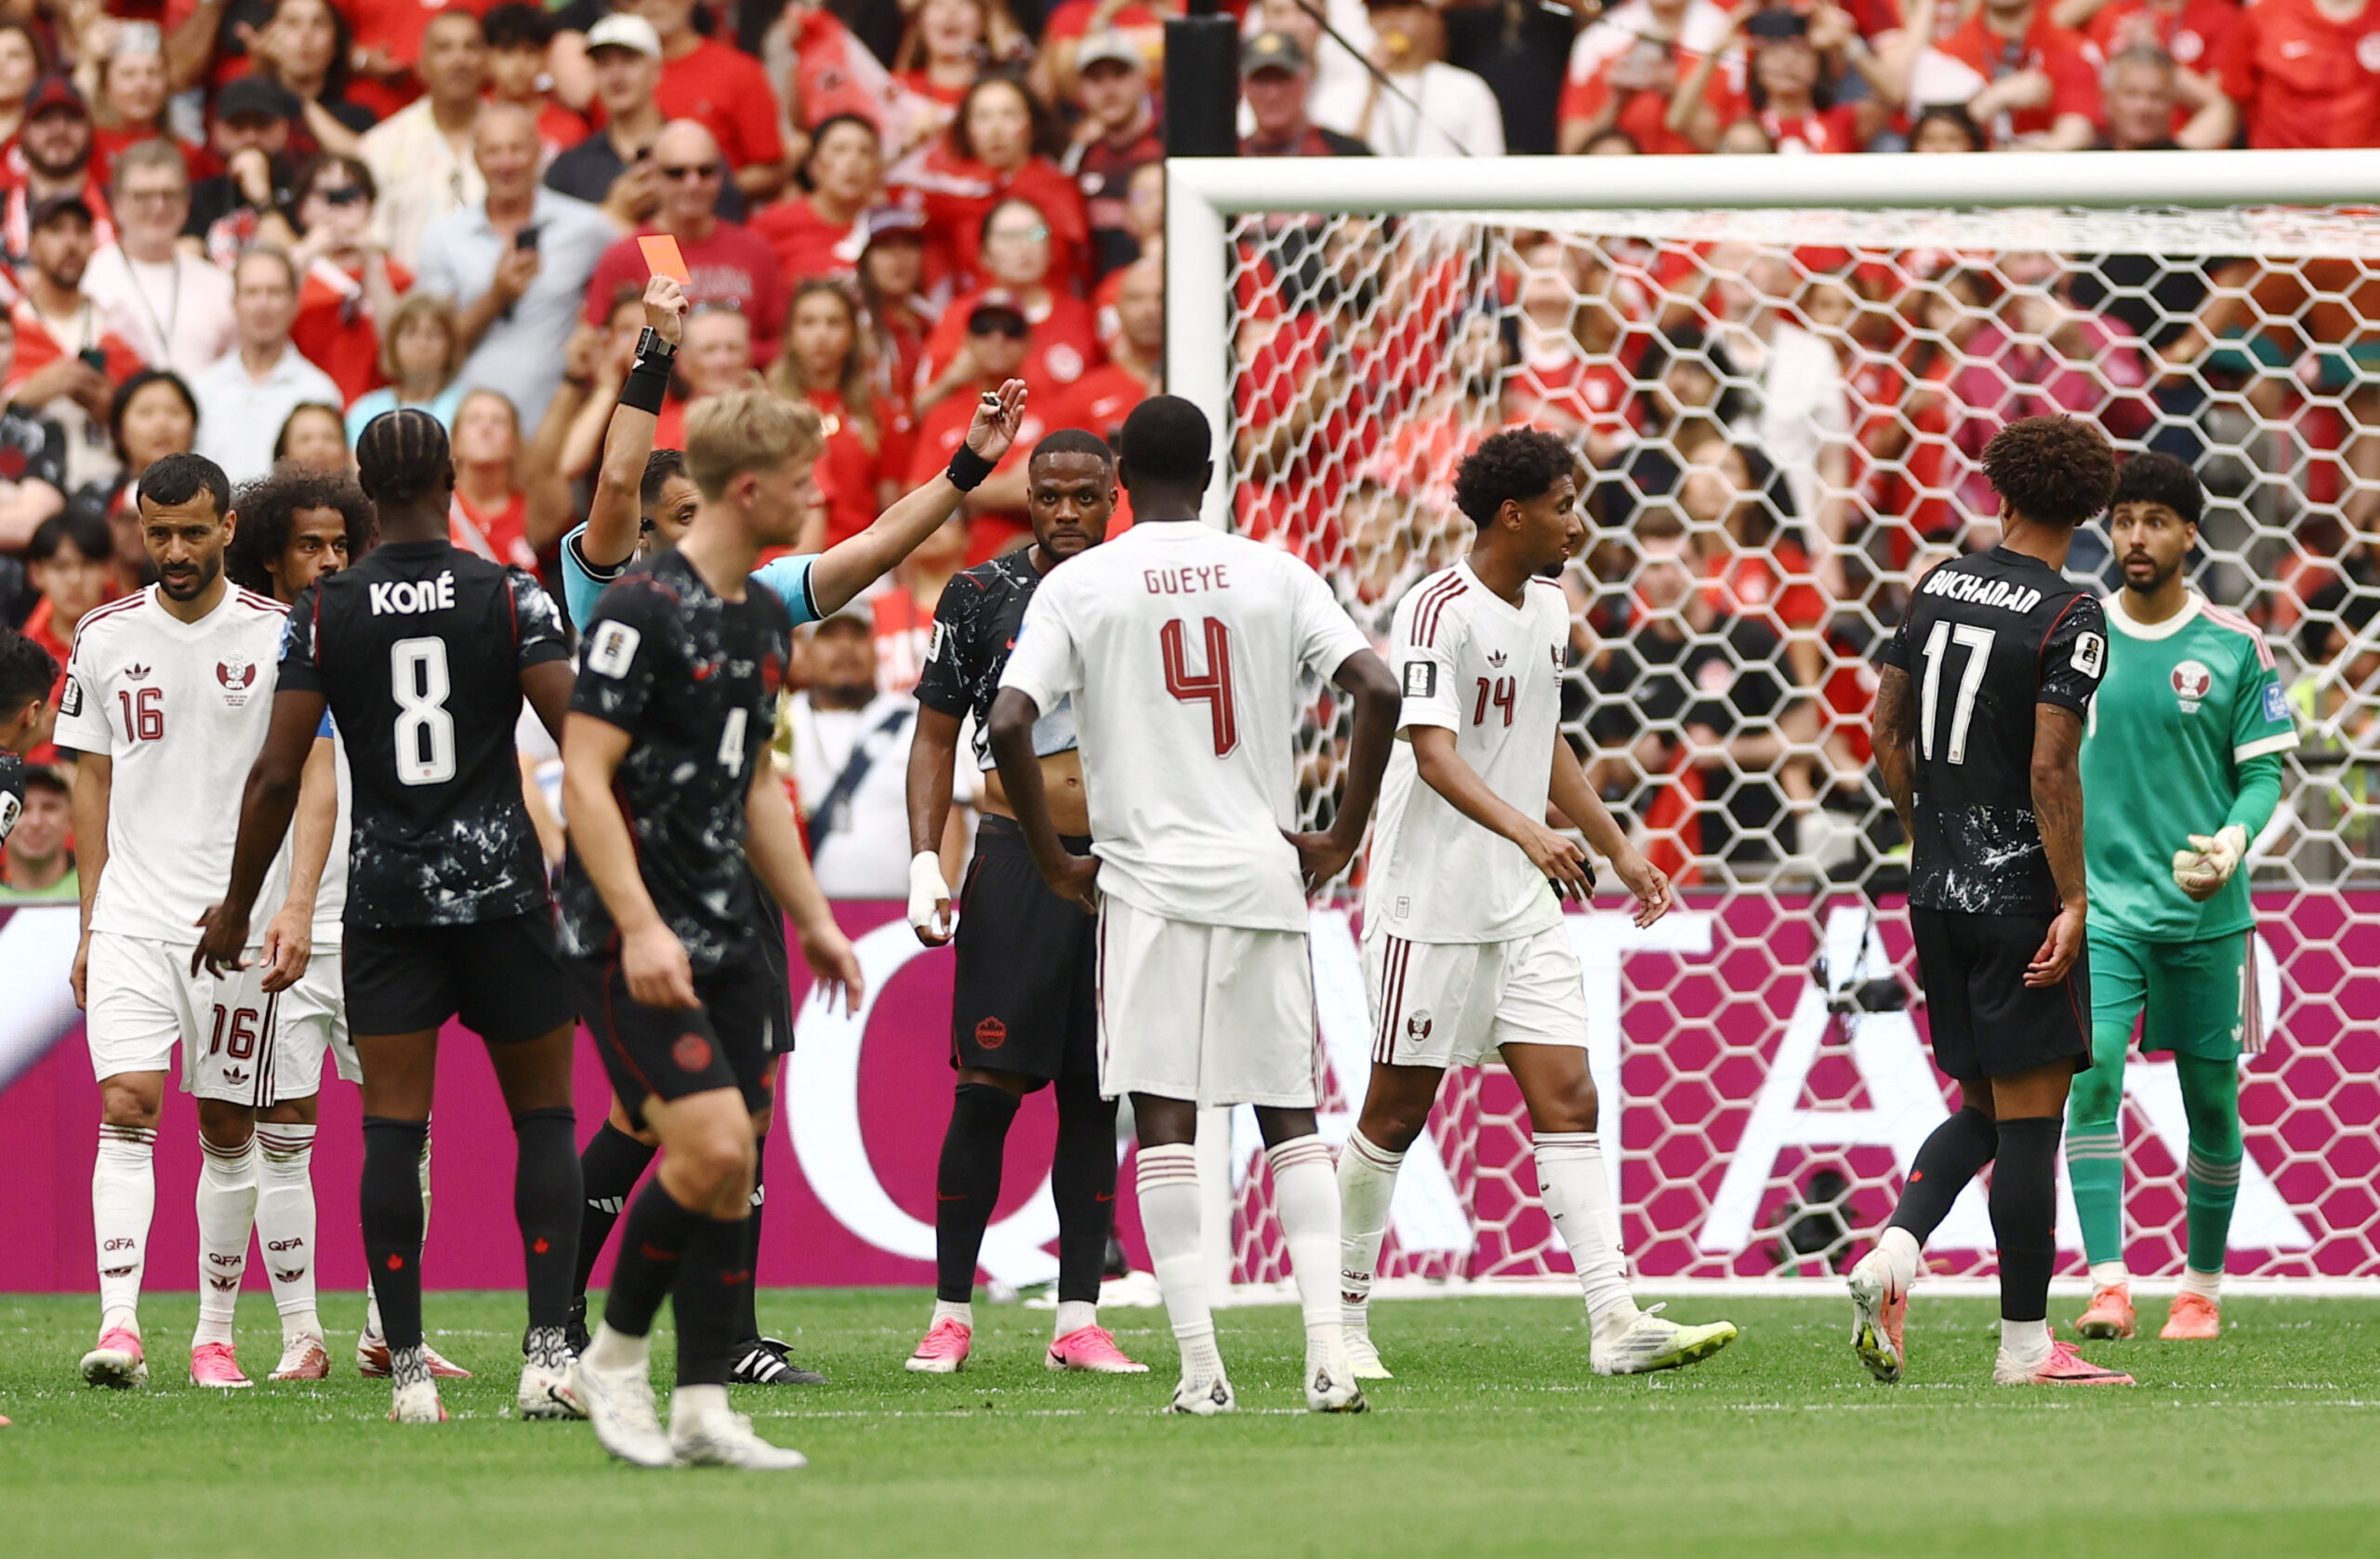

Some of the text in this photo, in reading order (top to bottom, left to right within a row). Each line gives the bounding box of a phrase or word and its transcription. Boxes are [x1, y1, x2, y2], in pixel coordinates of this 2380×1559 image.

[369, 570, 456, 616] KONÉ
[1144, 564, 1230, 594] GUEYE
[1923, 569, 2043, 614] BUCHANAN
[390, 635, 456, 786] 8
[1160, 616, 1240, 760] 4
[1473, 676, 1517, 728] 14
[1921, 619, 1997, 765] 17
[119, 687, 164, 743] 16
[717, 707, 748, 778] 4
[210, 1003, 258, 1060] 16
[103, 1237, 136, 1251] QFA
[208, 1252, 243, 1267] QFA
[268, 1236, 304, 1252] QFA
